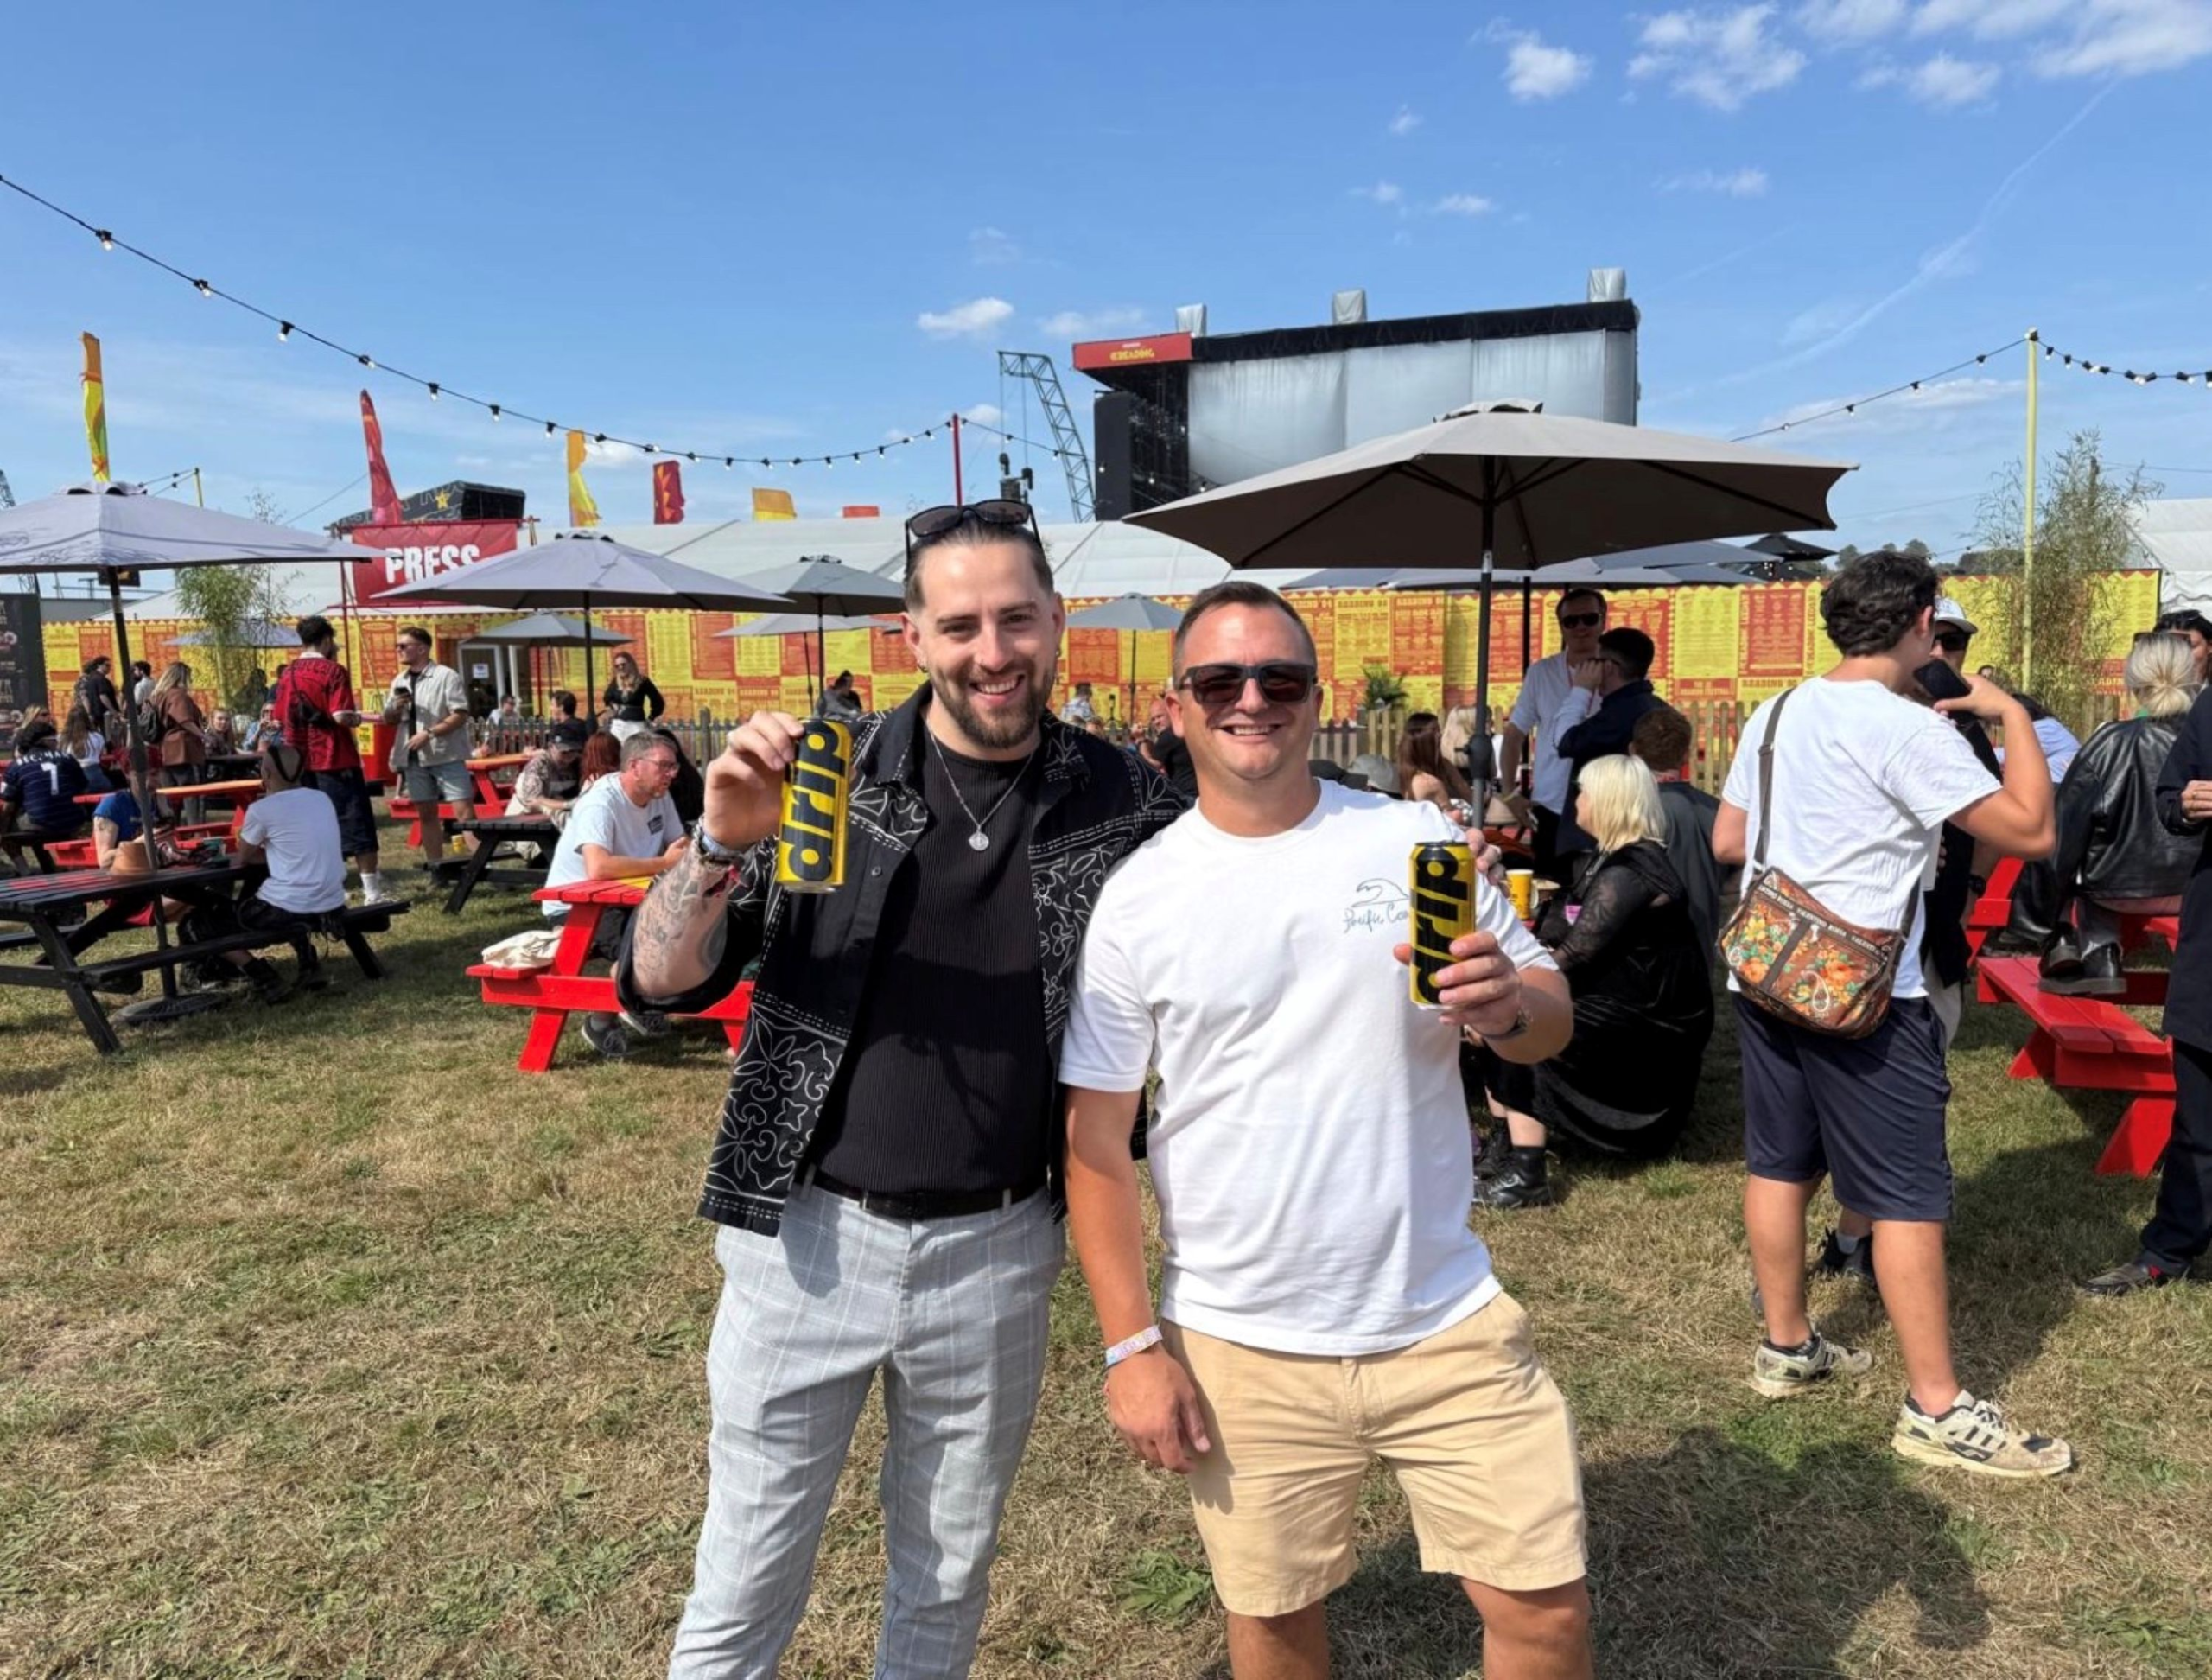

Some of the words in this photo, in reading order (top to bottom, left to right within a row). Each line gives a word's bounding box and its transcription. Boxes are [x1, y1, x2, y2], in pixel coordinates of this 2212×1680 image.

[385, 544, 480, 584] PRESS
[40, 761, 59, 795] 7
[782, 719, 845, 882] drip
[1414, 846, 1469, 1004] drip
